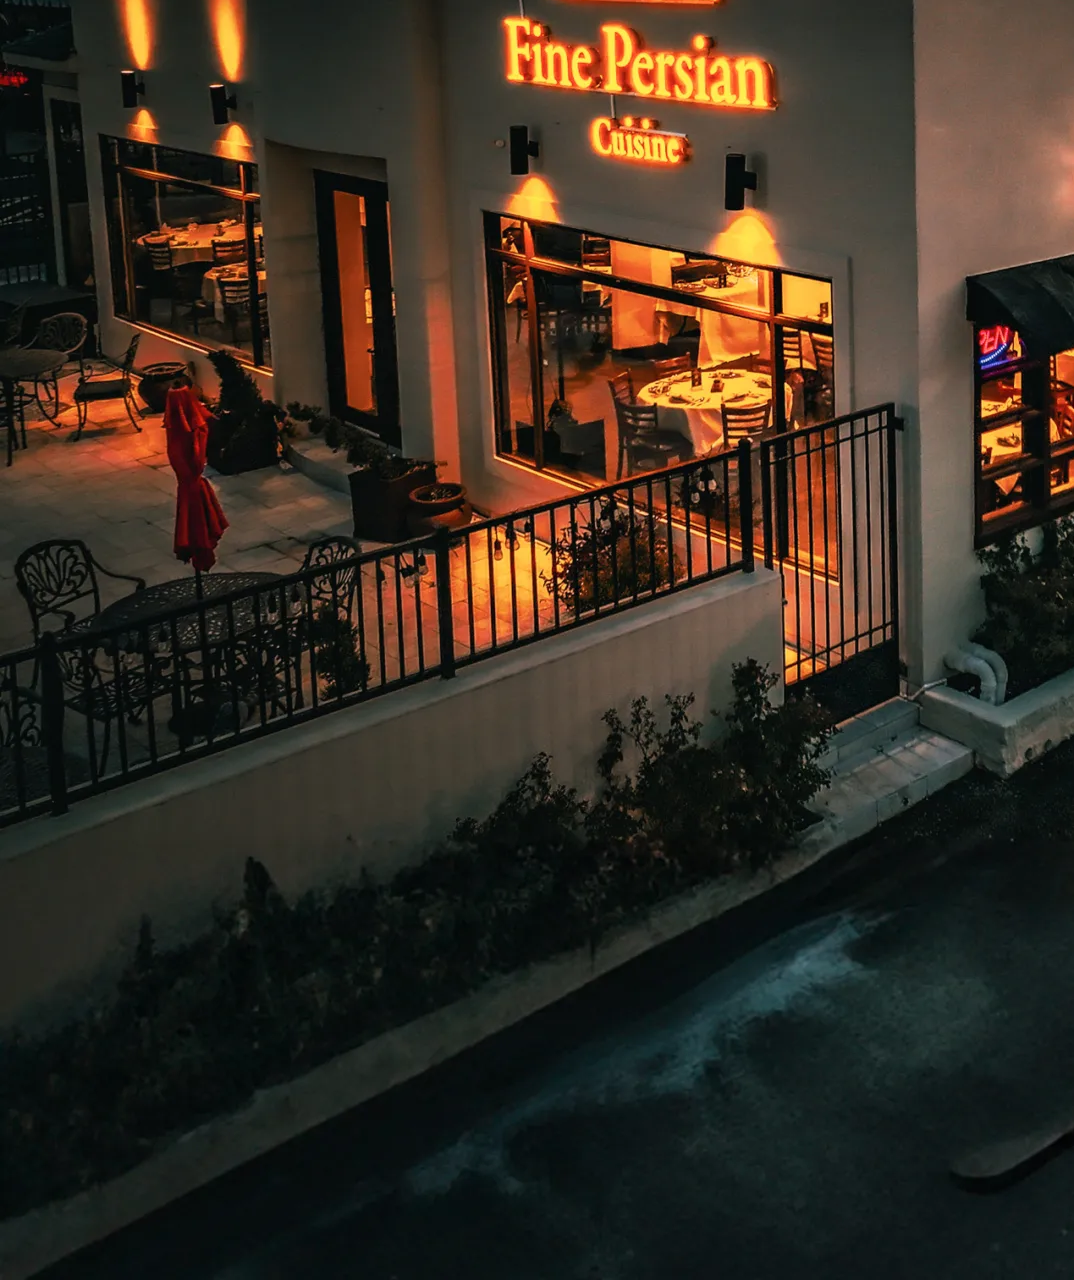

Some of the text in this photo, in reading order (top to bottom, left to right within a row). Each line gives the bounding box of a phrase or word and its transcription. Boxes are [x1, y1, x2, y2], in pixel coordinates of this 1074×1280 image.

[503, 17, 770, 108] Fine Persian
[591, 116, 681, 164] Cuisine
